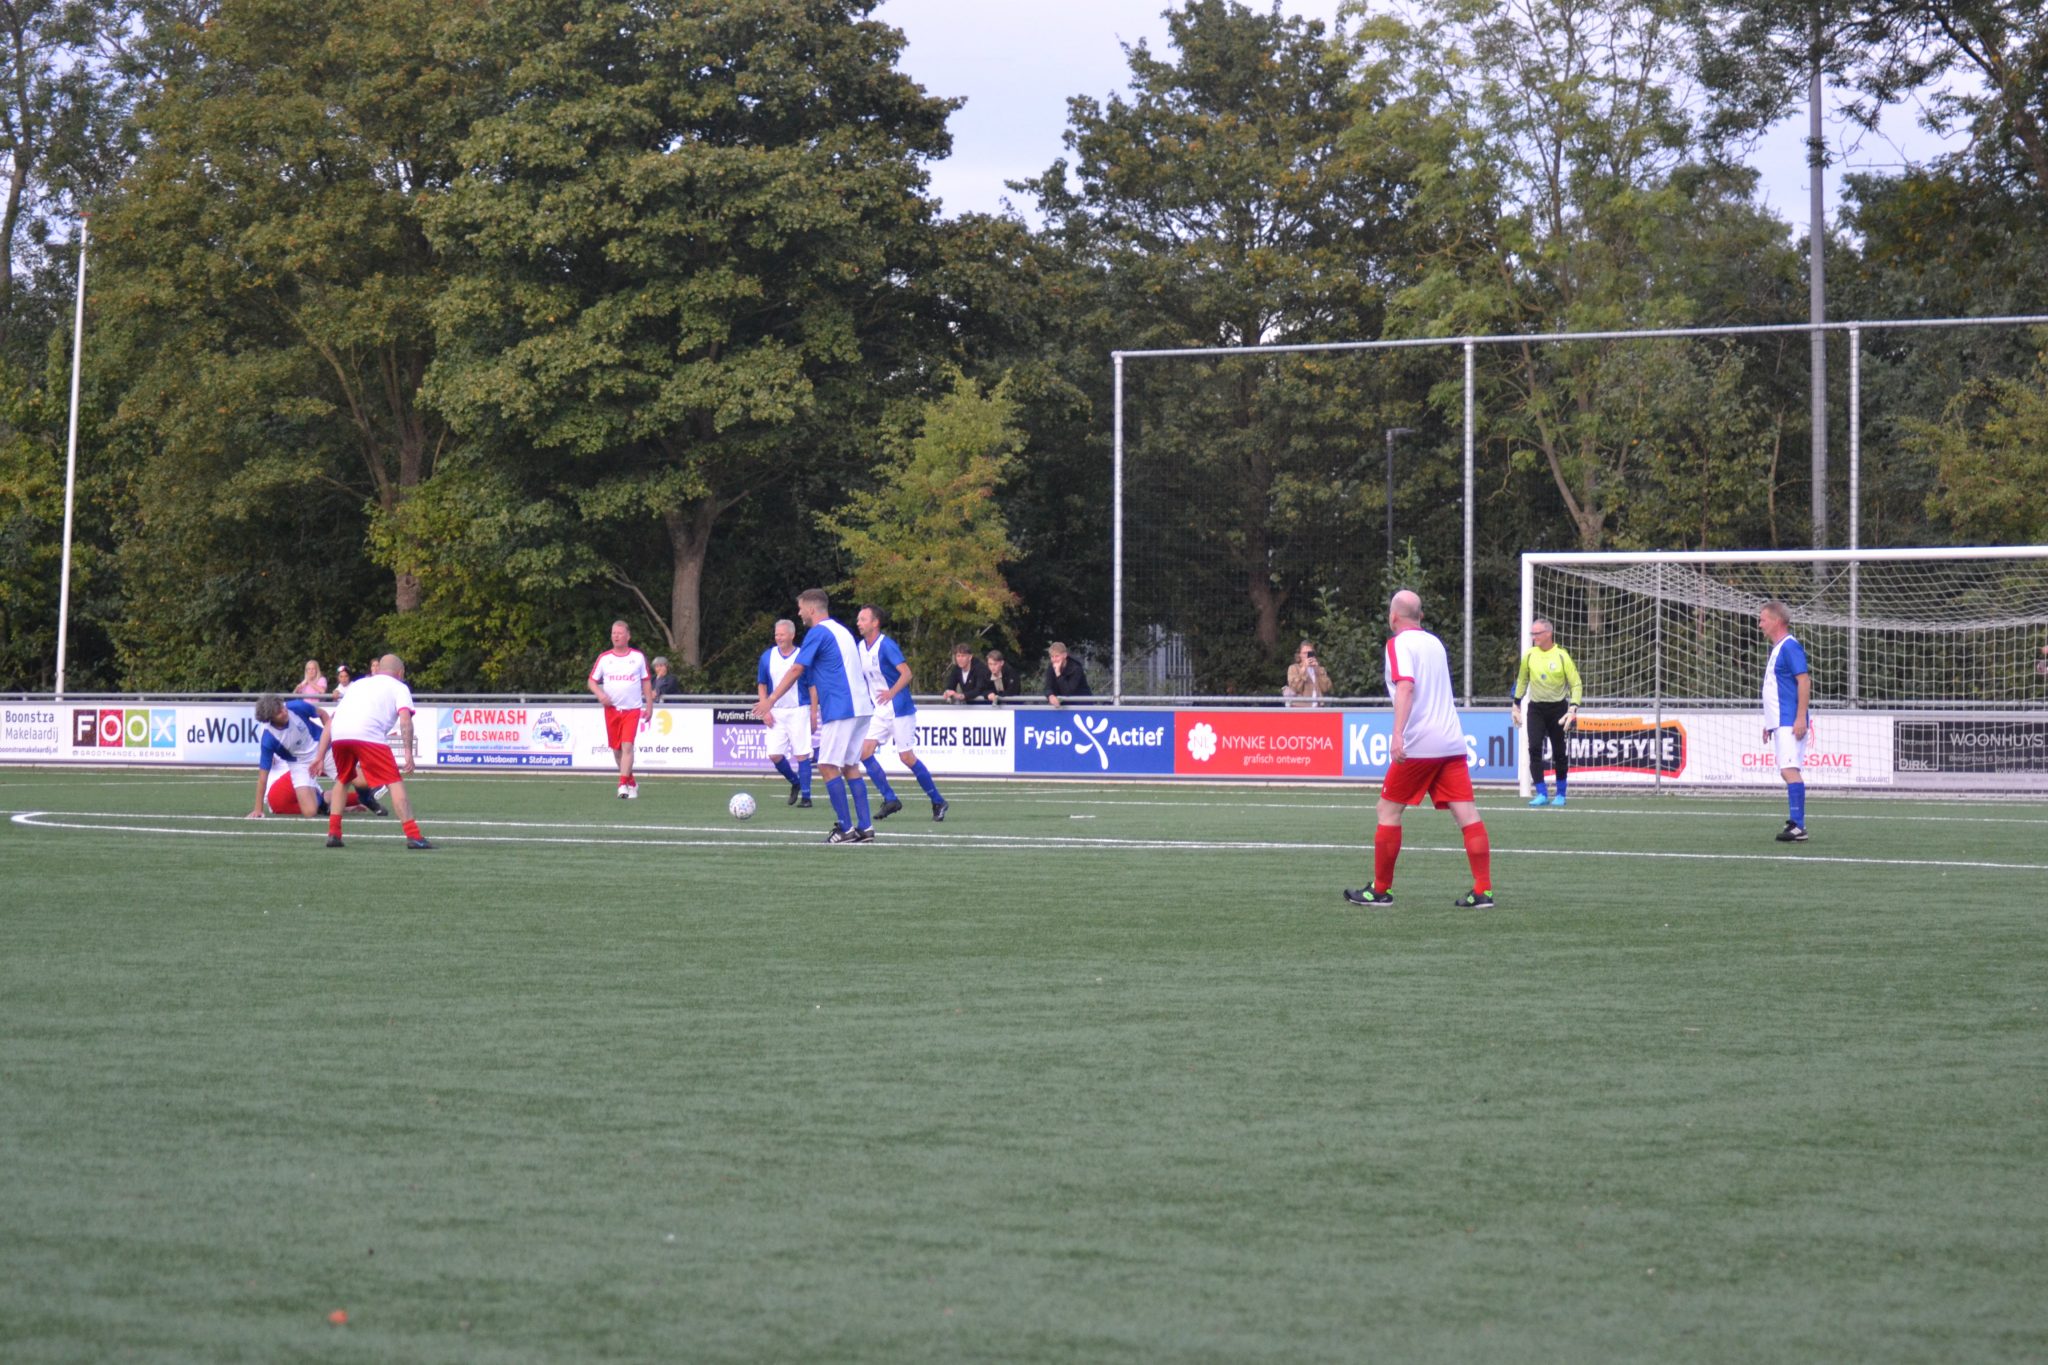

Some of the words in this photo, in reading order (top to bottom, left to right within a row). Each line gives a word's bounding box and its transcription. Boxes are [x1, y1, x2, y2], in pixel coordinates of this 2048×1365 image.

[5, 711, 54, 723] Boonstra
[453, 710, 527, 724] CARWASH
[717, 711, 744, 722] Anytime
[5, 727, 59, 743] Makelaardij
[77, 715, 173, 742] FOOX
[460, 731, 519, 741] BOLSWARD
[963, 727, 1007, 746] BOUW
[1024, 726, 1072, 749] Fysio
[1107, 727, 1165, 746] Actief
[1222, 736, 1265, 749] NYNKE
[1270, 736, 1333, 750] LOOTSMA
[1950, 733, 2045, 748] WOONHUYS
[656, 744, 669, 753] der
[1349, 723, 1514, 767] Kes.nl
[1543, 736, 1674, 761] JMPSTYLE
[1243, 754, 1274, 765] grafisch
[1276, 755, 1311, 765] ontwerp
[1900, 759, 1929, 769] DIRK
